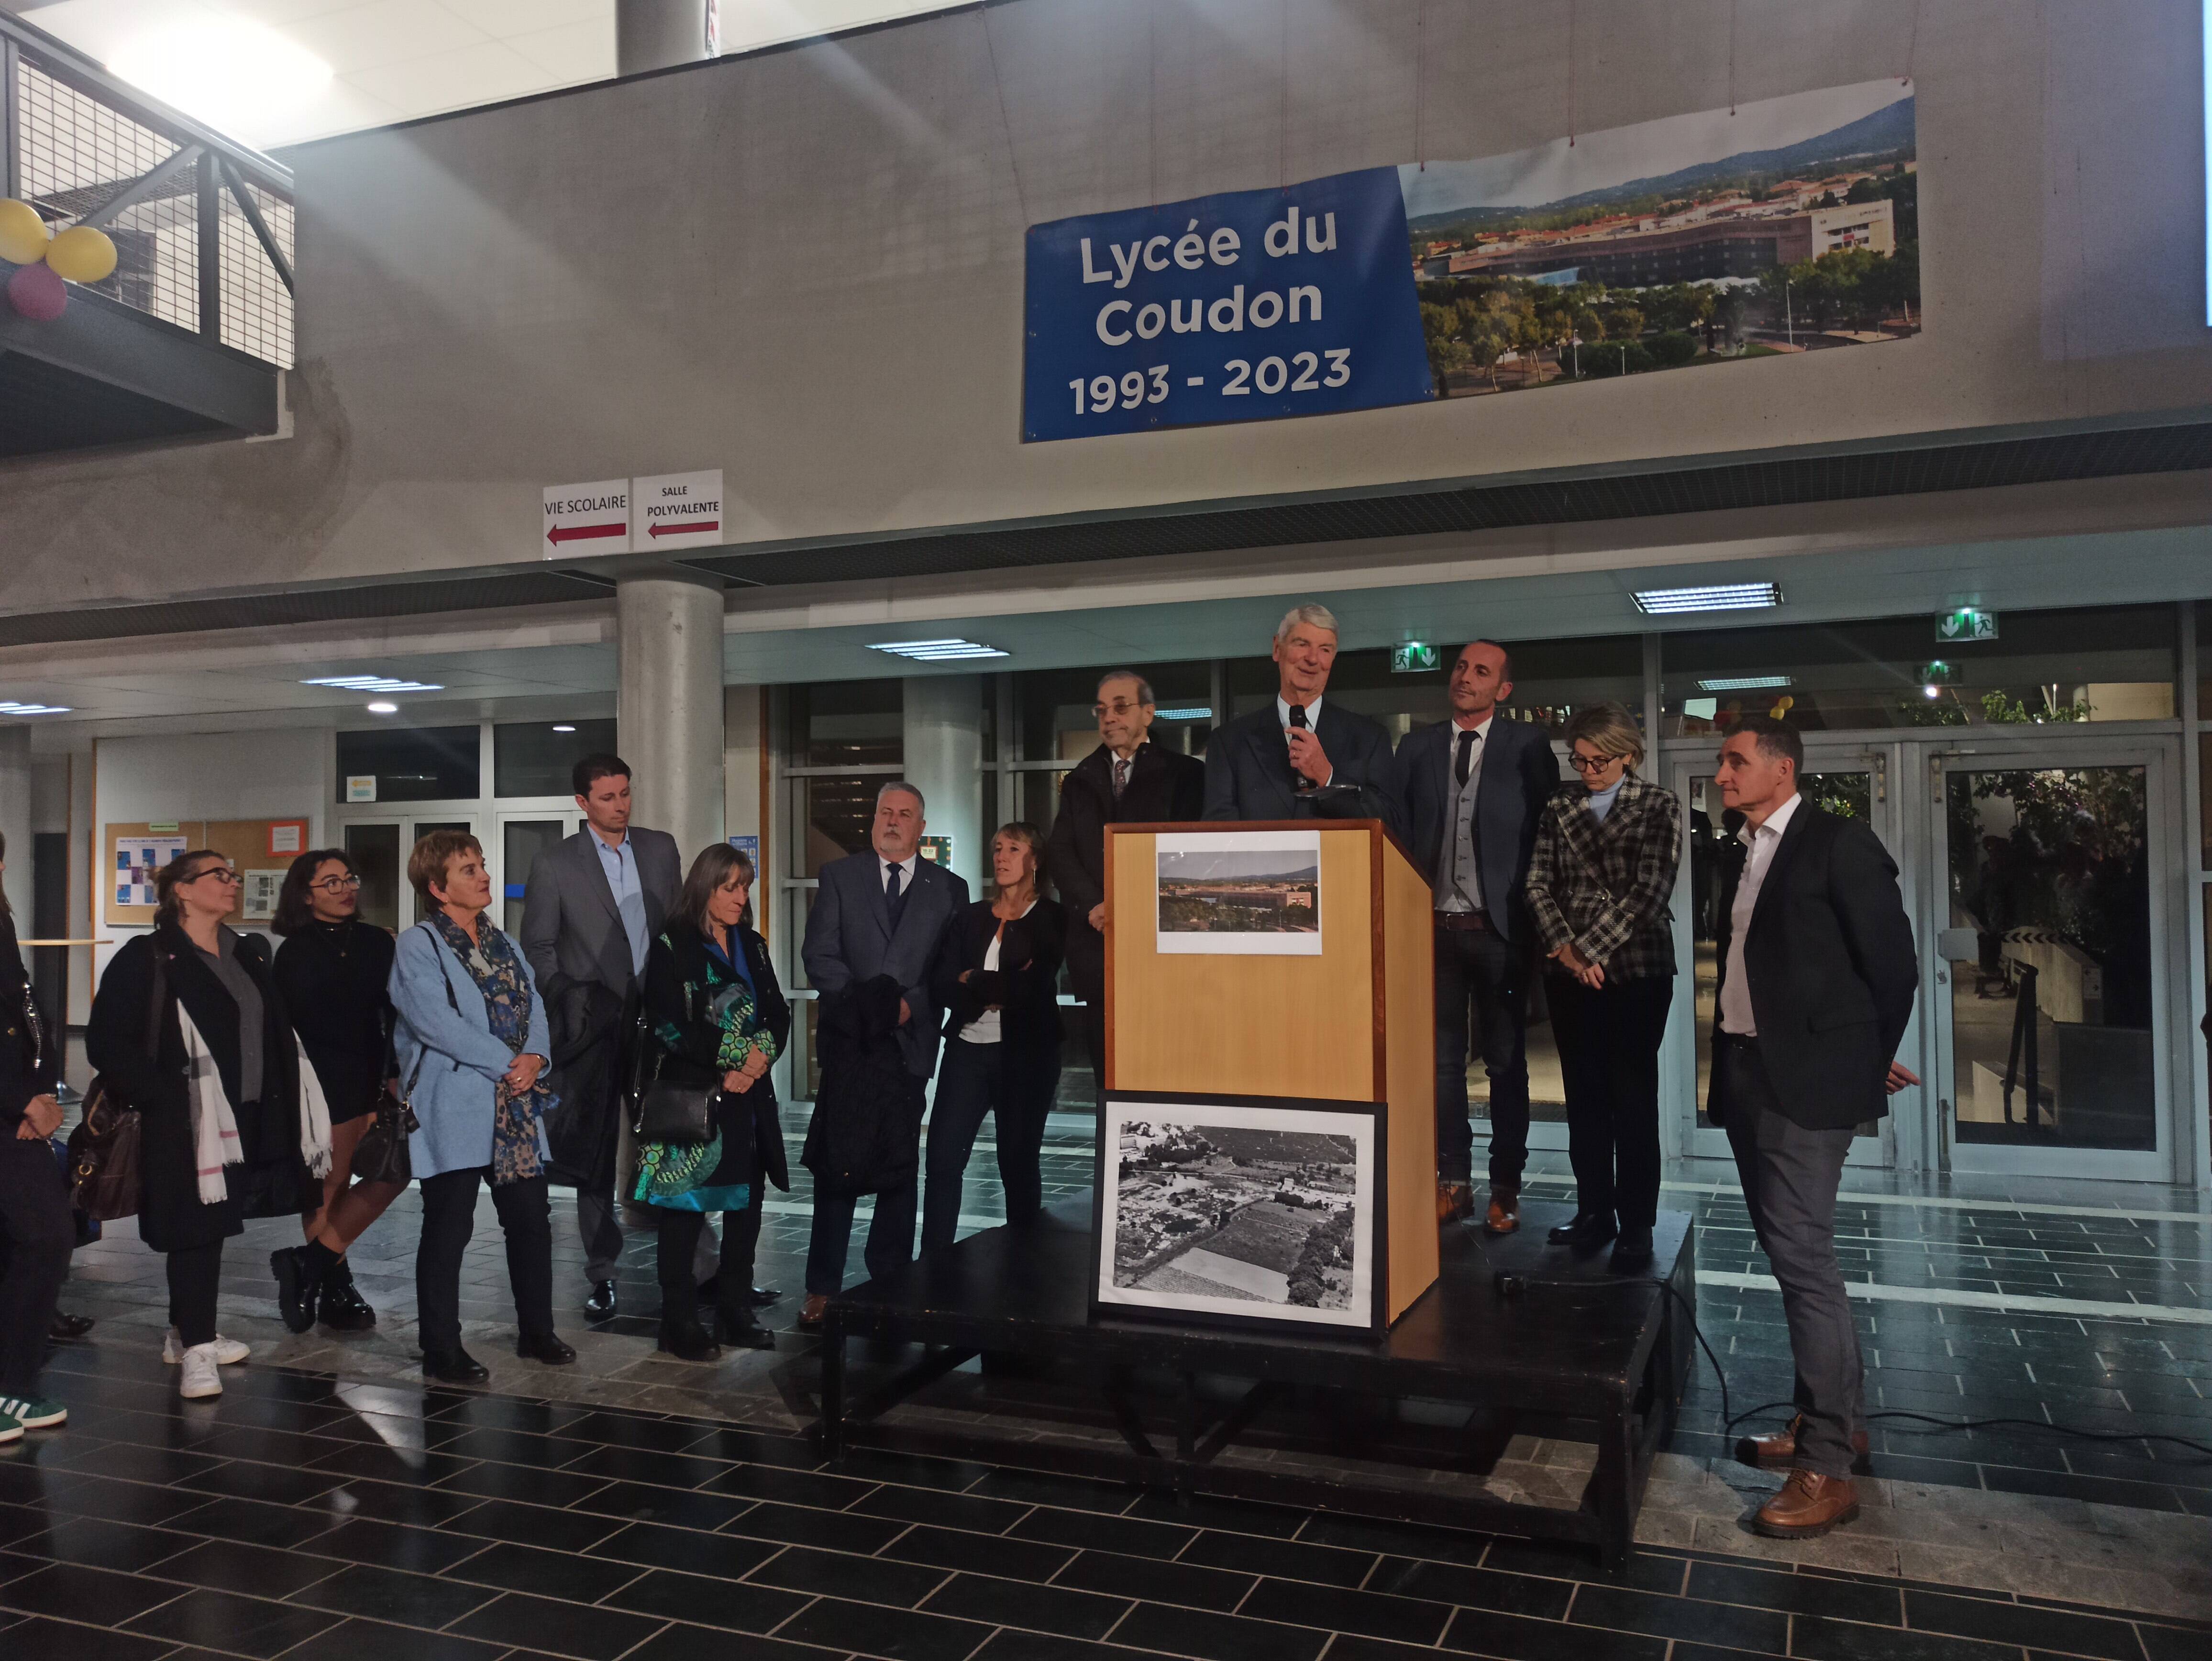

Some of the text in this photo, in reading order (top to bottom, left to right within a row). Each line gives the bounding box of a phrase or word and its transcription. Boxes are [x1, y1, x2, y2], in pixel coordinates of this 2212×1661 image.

[1081, 207, 1337, 288] Lycée du
[1096, 284, 1322, 346] Coudon
[1069, 348, 1351, 415] 1993 - 2023
[544, 495, 627, 515] VIE SCOLAIRE
[647, 501, 719, 517] POLYVALENTE
[662, 486, 688, 497] SALLE
